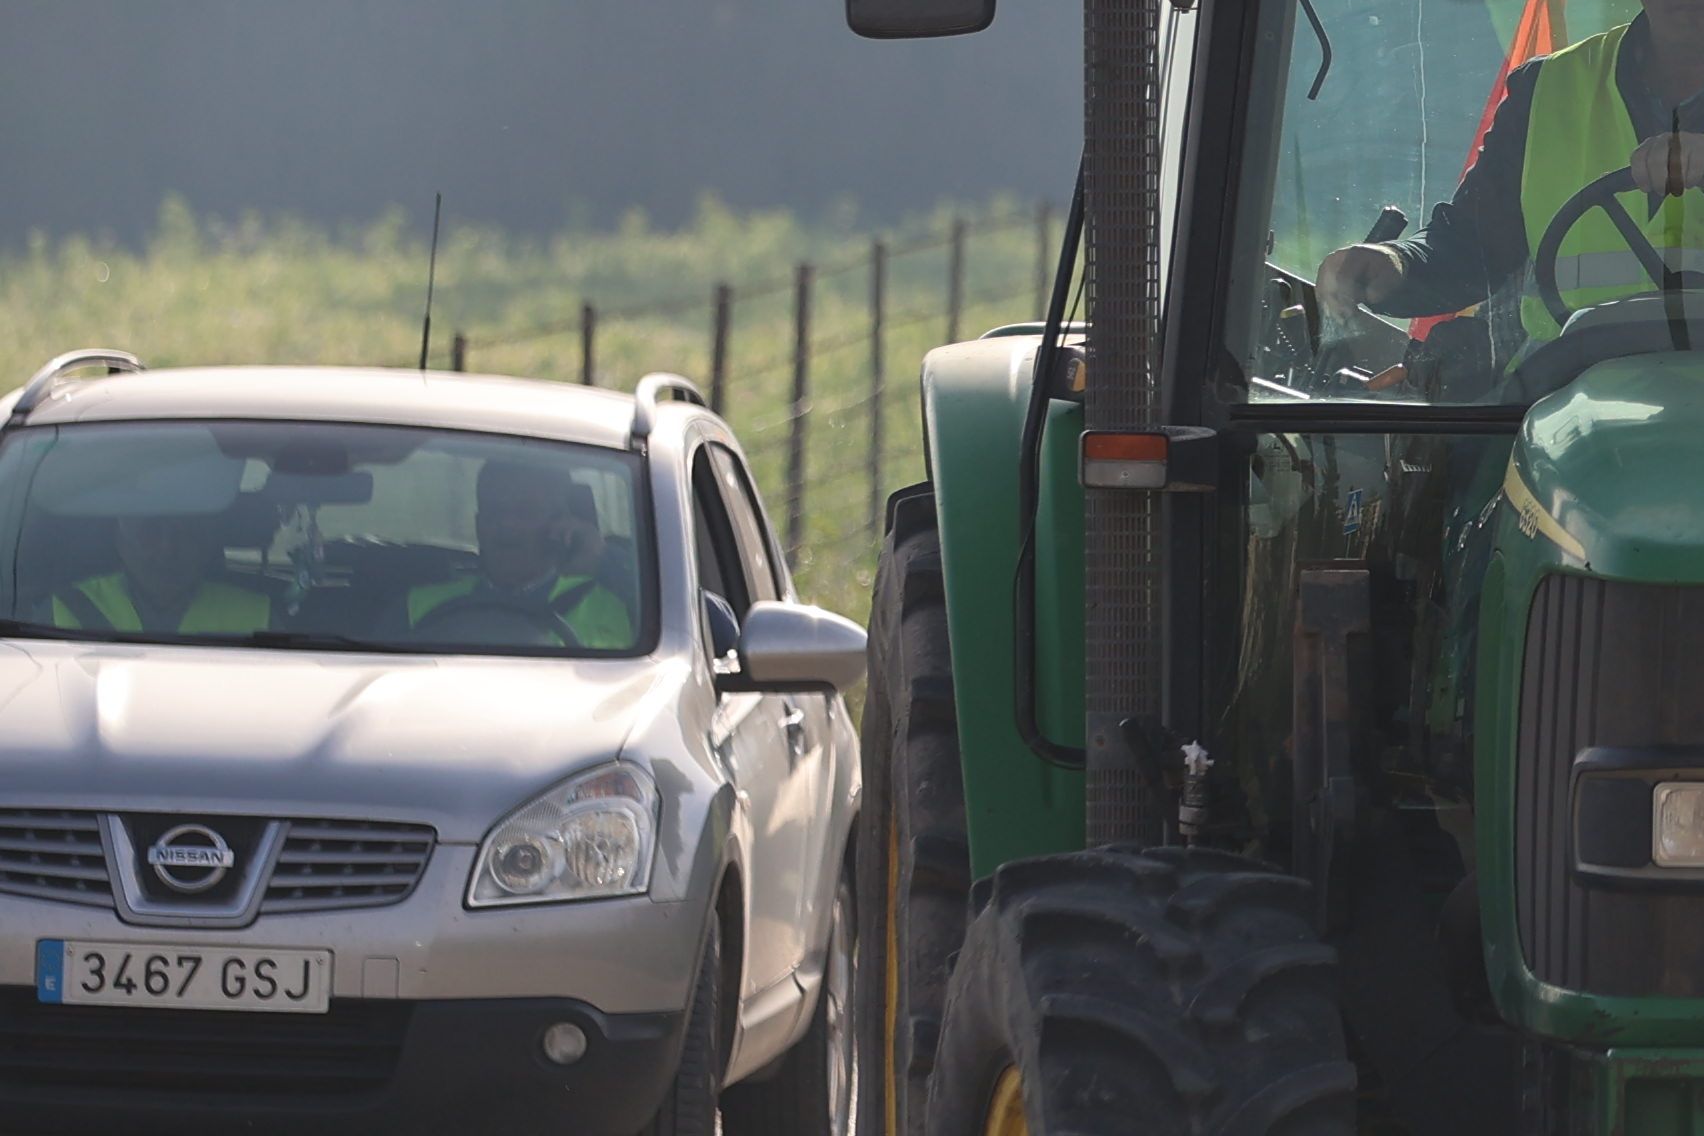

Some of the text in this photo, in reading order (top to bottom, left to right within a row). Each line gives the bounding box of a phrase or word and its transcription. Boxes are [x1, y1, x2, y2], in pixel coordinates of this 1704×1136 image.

[156, 848, 224, 864] NISSAN
[45, 975, 57, 992] E
[81, 952, 310, 1001] 3467 GSJ
